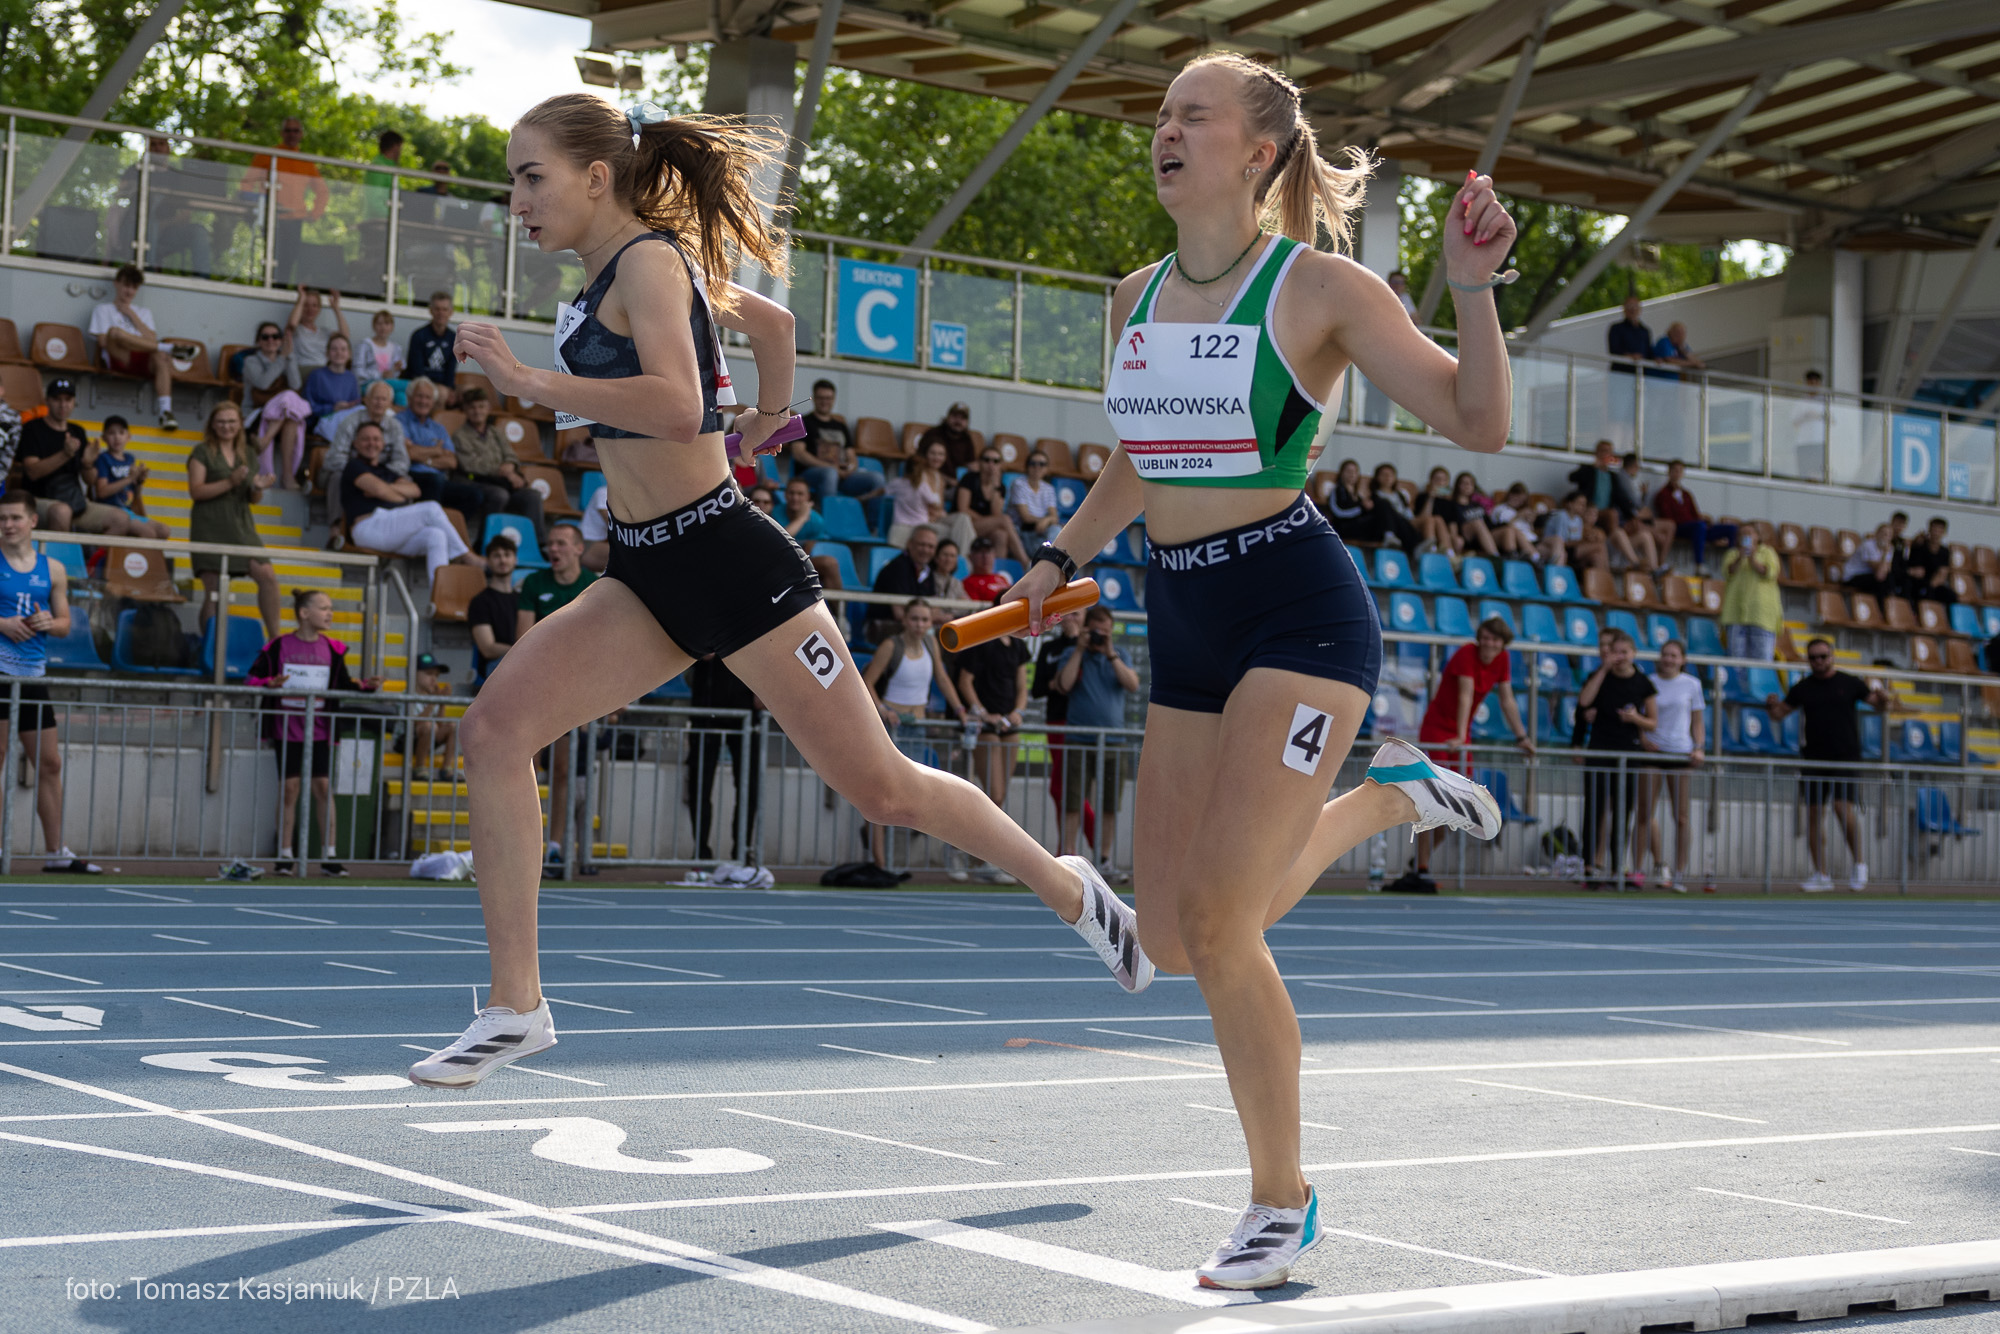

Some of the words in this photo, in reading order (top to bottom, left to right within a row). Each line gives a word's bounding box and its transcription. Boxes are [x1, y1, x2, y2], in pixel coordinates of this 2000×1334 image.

[852, 267, 903, 288] SEKTOR
[855, 289, 899, 353] C
[933, 327, 963, 351] WC
[1190, 334, 1240, 359] 122
[1122, 360, 1147, 370] ORLEN
[1107, 397, 1245, 415] NOWAKOWSKA
[1138, 458, 1179, 470] LUBLIN
[1181, 457, 1213, 469] 2024
[1151, 443, 1171, 451] POLSKI
[1172, 443, 1178, 451] W
[1902, 437, 1931, 486] D
[616, 520, 672, 548] NIKE
[675, 487, 736, 536] PRO
[1160, 538, 1231, 571] NIKE
[1237, 505, 1309, 555] PRO
[801, 633, 835, 677] 5
[1290, 713, 1327, 764] 4
[403, 1116, 777, 1175] 2
